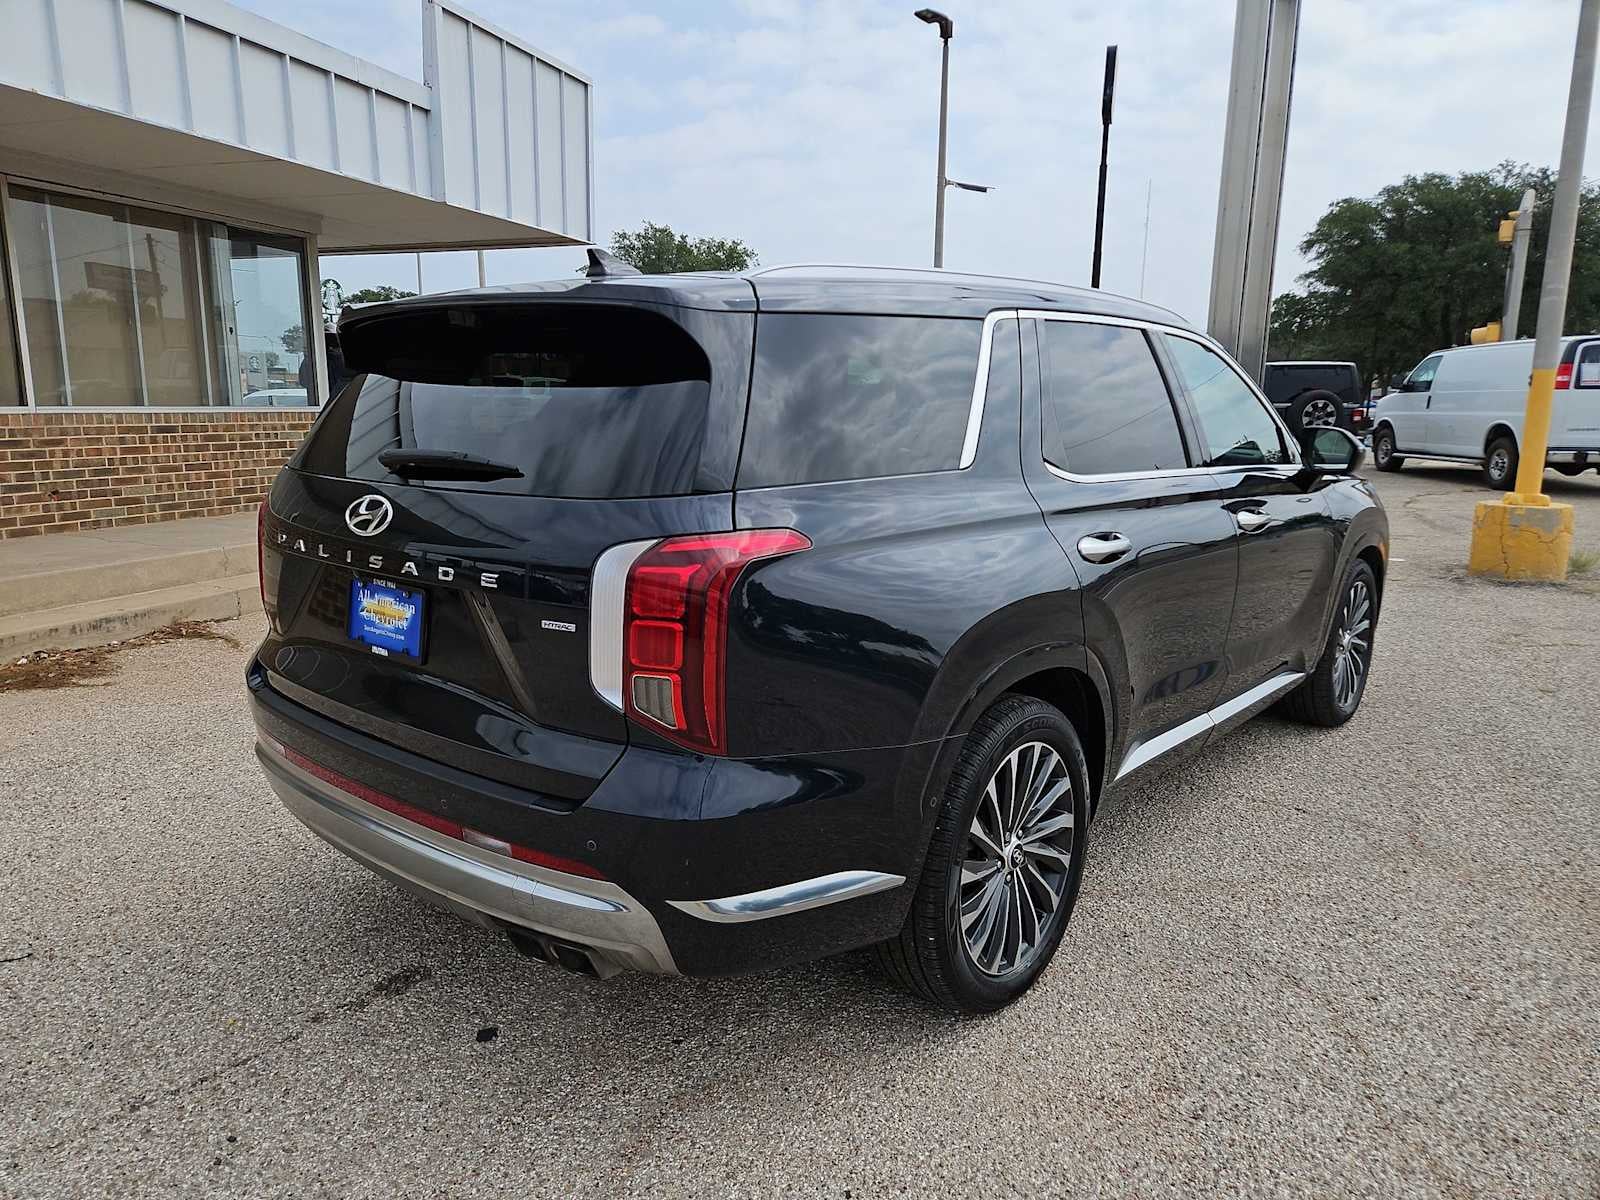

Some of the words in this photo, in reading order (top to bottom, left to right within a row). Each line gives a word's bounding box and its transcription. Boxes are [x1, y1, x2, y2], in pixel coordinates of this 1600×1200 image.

[277, 533, 500, 588] PALISADE
[357, 589, 371, 602] All
[371, 592, 416, 615] American
[363, 607, 409, 631] Chevrolet
